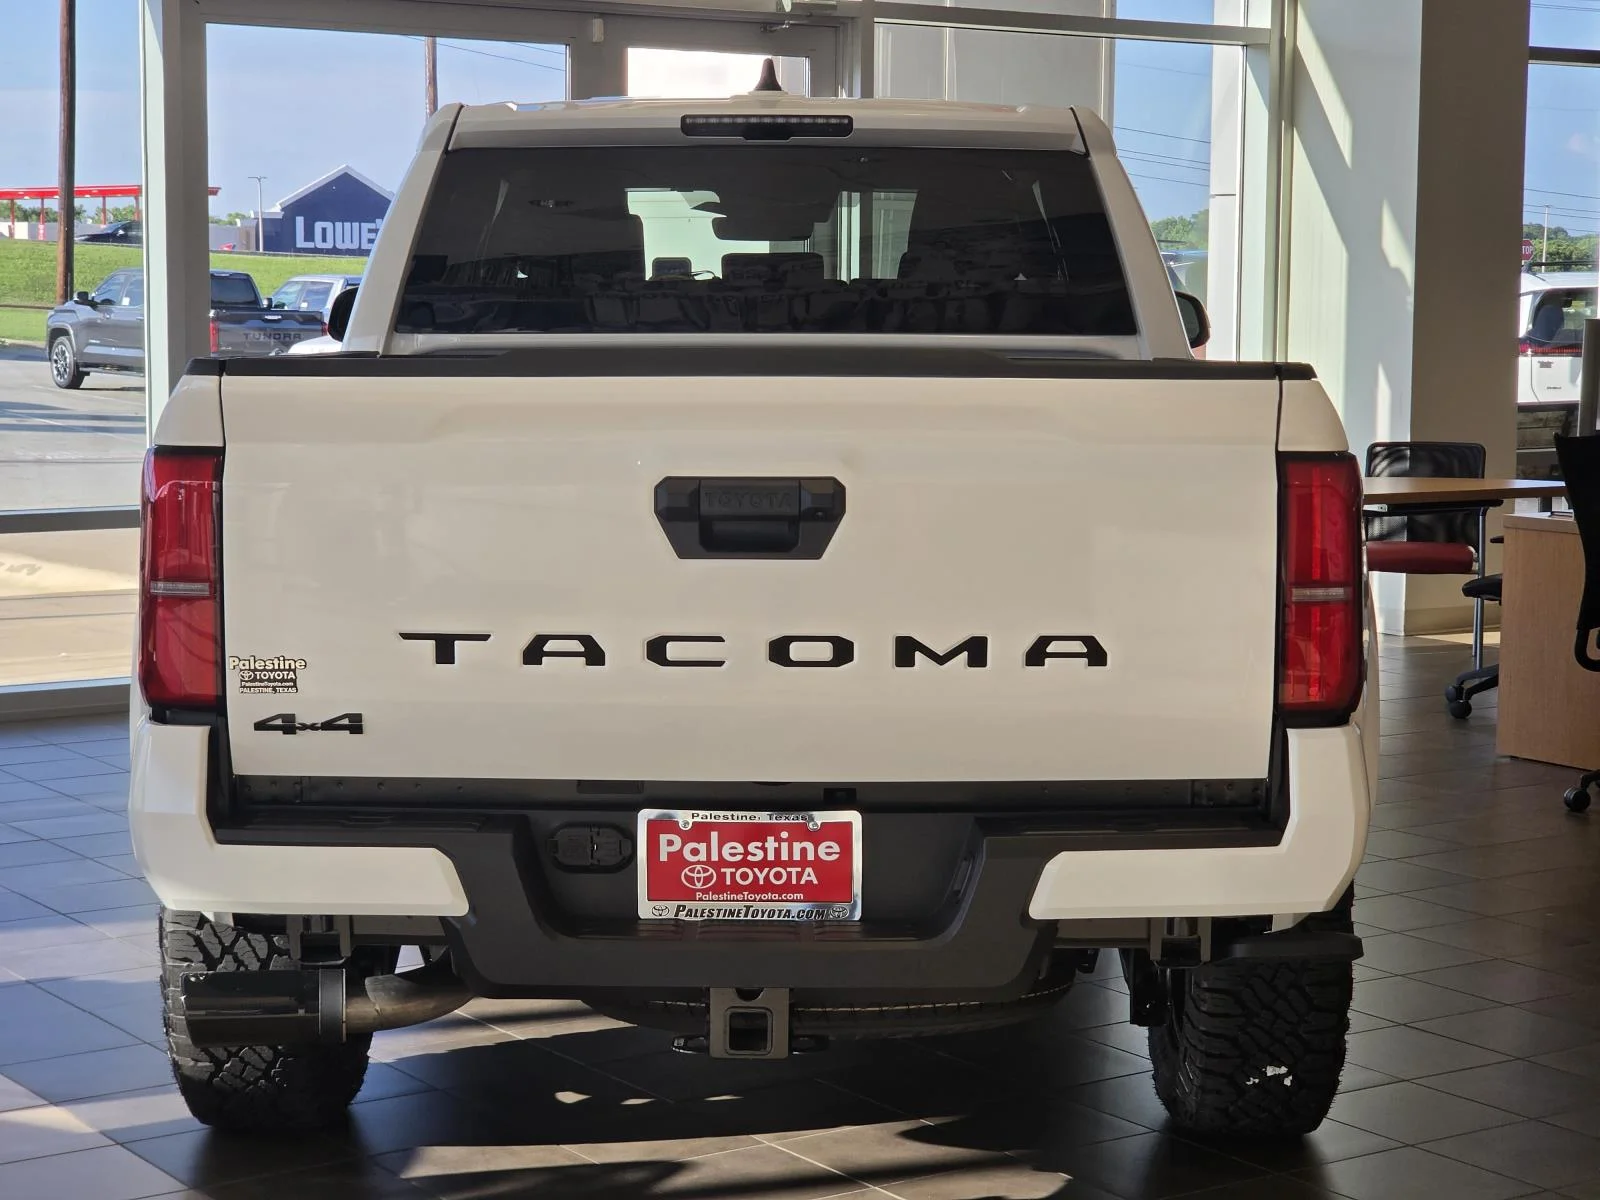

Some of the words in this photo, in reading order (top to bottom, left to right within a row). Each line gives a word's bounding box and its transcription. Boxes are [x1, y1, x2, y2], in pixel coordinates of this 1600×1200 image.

[296, 216, 383, 249] LOWE'
[1522, 245, 1534, 255] TOP
[243, 332, 302, 340] TUNDRA
[704, 491, 793, 509] TOYOTA
[399, 632, 1107, 669] TACOMA
[229, 655, 307, 670] Palestine
[254, 671, 296, 680] TOYOTA
[254, 712, 363, 735] 4x4
[766, 813, 808, 822] Texas
[659, 831, 841, 862] Palestine
[720, 867, 819, 885] TOYOTA
[695, 891, 804, 901] PalestineToyota.com
